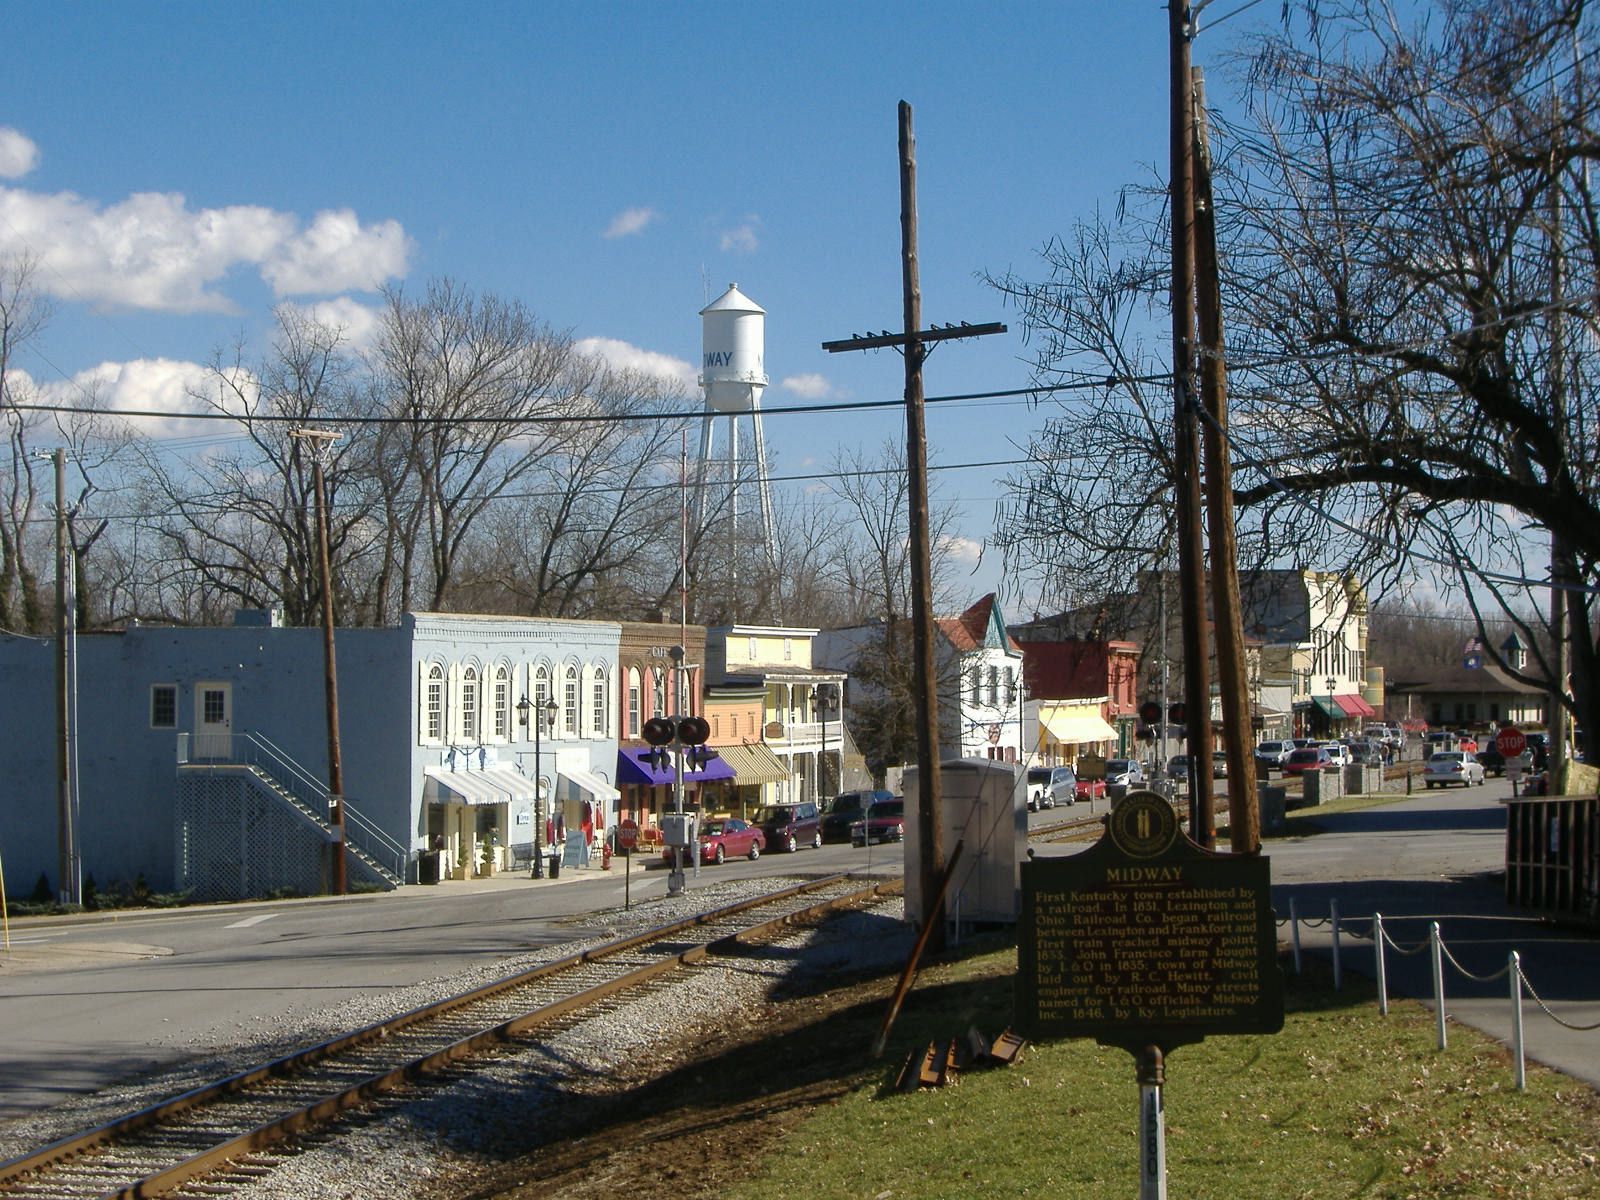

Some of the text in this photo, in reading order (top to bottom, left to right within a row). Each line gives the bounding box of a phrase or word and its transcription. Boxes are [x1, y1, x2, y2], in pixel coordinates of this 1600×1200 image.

[704, 351, 733, 368] WAY
[1497, 737, 1523, 749] STOP
[619, 828, 636, 839] STOP
[1106, 866, 1182, 882] MIDWAY
[1035, 887, 1257, 902] First Kentucky town established by
[1114, 901, 1128, 912] In
[1167, 900, 1228, 913] Lexington
[1233, 899, 1257, 910] and
[1035, 914, 1065, 926] Ohio
[1073, 913, 1127, 925] Railroad
[1162, 912, 1199, 926] began
[1207, 911, 1257, 922] railroad
[1036, 923, 1257, 938] between Lexington and Frankfort and
[1036, 939, 1065, 950] first
[1072, 938, 1103, 949] train
[1111, 936, 1160, 948] reached
[1168, 935, 1214, 948] midway
[1076, 949, 1106, 960] John
[1114, 947, 1172, 959] Francisco
[1180, 947, 1208, 958] farm
[1215, 946, 1258, 959] bought
[1037, 962, 1051, 974] by
[1157, 960, 1186, 970] town
[1192, 959, 1206, 970] of
[1212, 958, 1258, 971] Midway
[1038, 973, 1062, 985] laid
[1072, 973, 1094, 984] out
[1105, 972, 1120, 985] by
[1231, 968, 1259, 980] civil
[1038, 985, 1089, 998] engineer
[1095, 984, 1112, 995] for
[1176, 981, 1211, 995] Many
[1215, 981, 1260, 993] streets
[1039, 996, 1078, 1008] named
[1084, 996, 1103, 1007] for
[1212, 993, 1260, 1006] Midway
[1115, 1007, 1130, 1020] by
